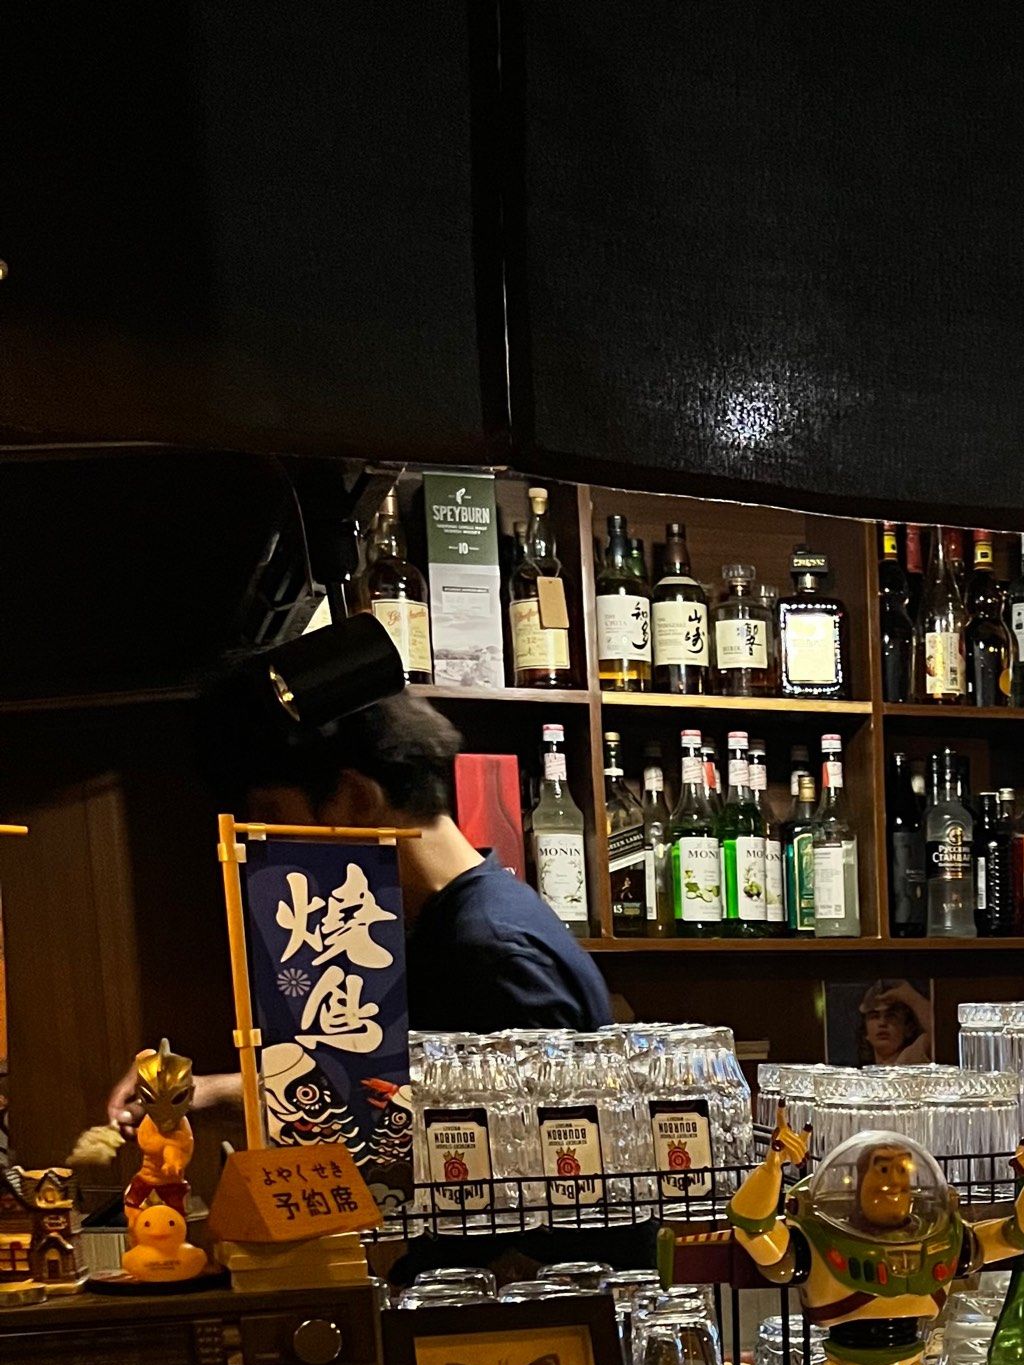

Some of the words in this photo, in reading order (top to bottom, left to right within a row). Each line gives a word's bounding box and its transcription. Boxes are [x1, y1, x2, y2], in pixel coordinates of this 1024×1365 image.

[432, 504, 491, 524] SPEYBURN
[458, 542, 469, 555] 10
[539, 847, 581, 857] MONIN
[658, 1122, 697, 1133] BOURBON
[434, 1132, 476, 1143] BOURBON
[547, 1128, 587, 1140] BOURBON
[262, 1160, 343, 1186] よやくせき
[272, 1185, 359, 1220] 予約席
